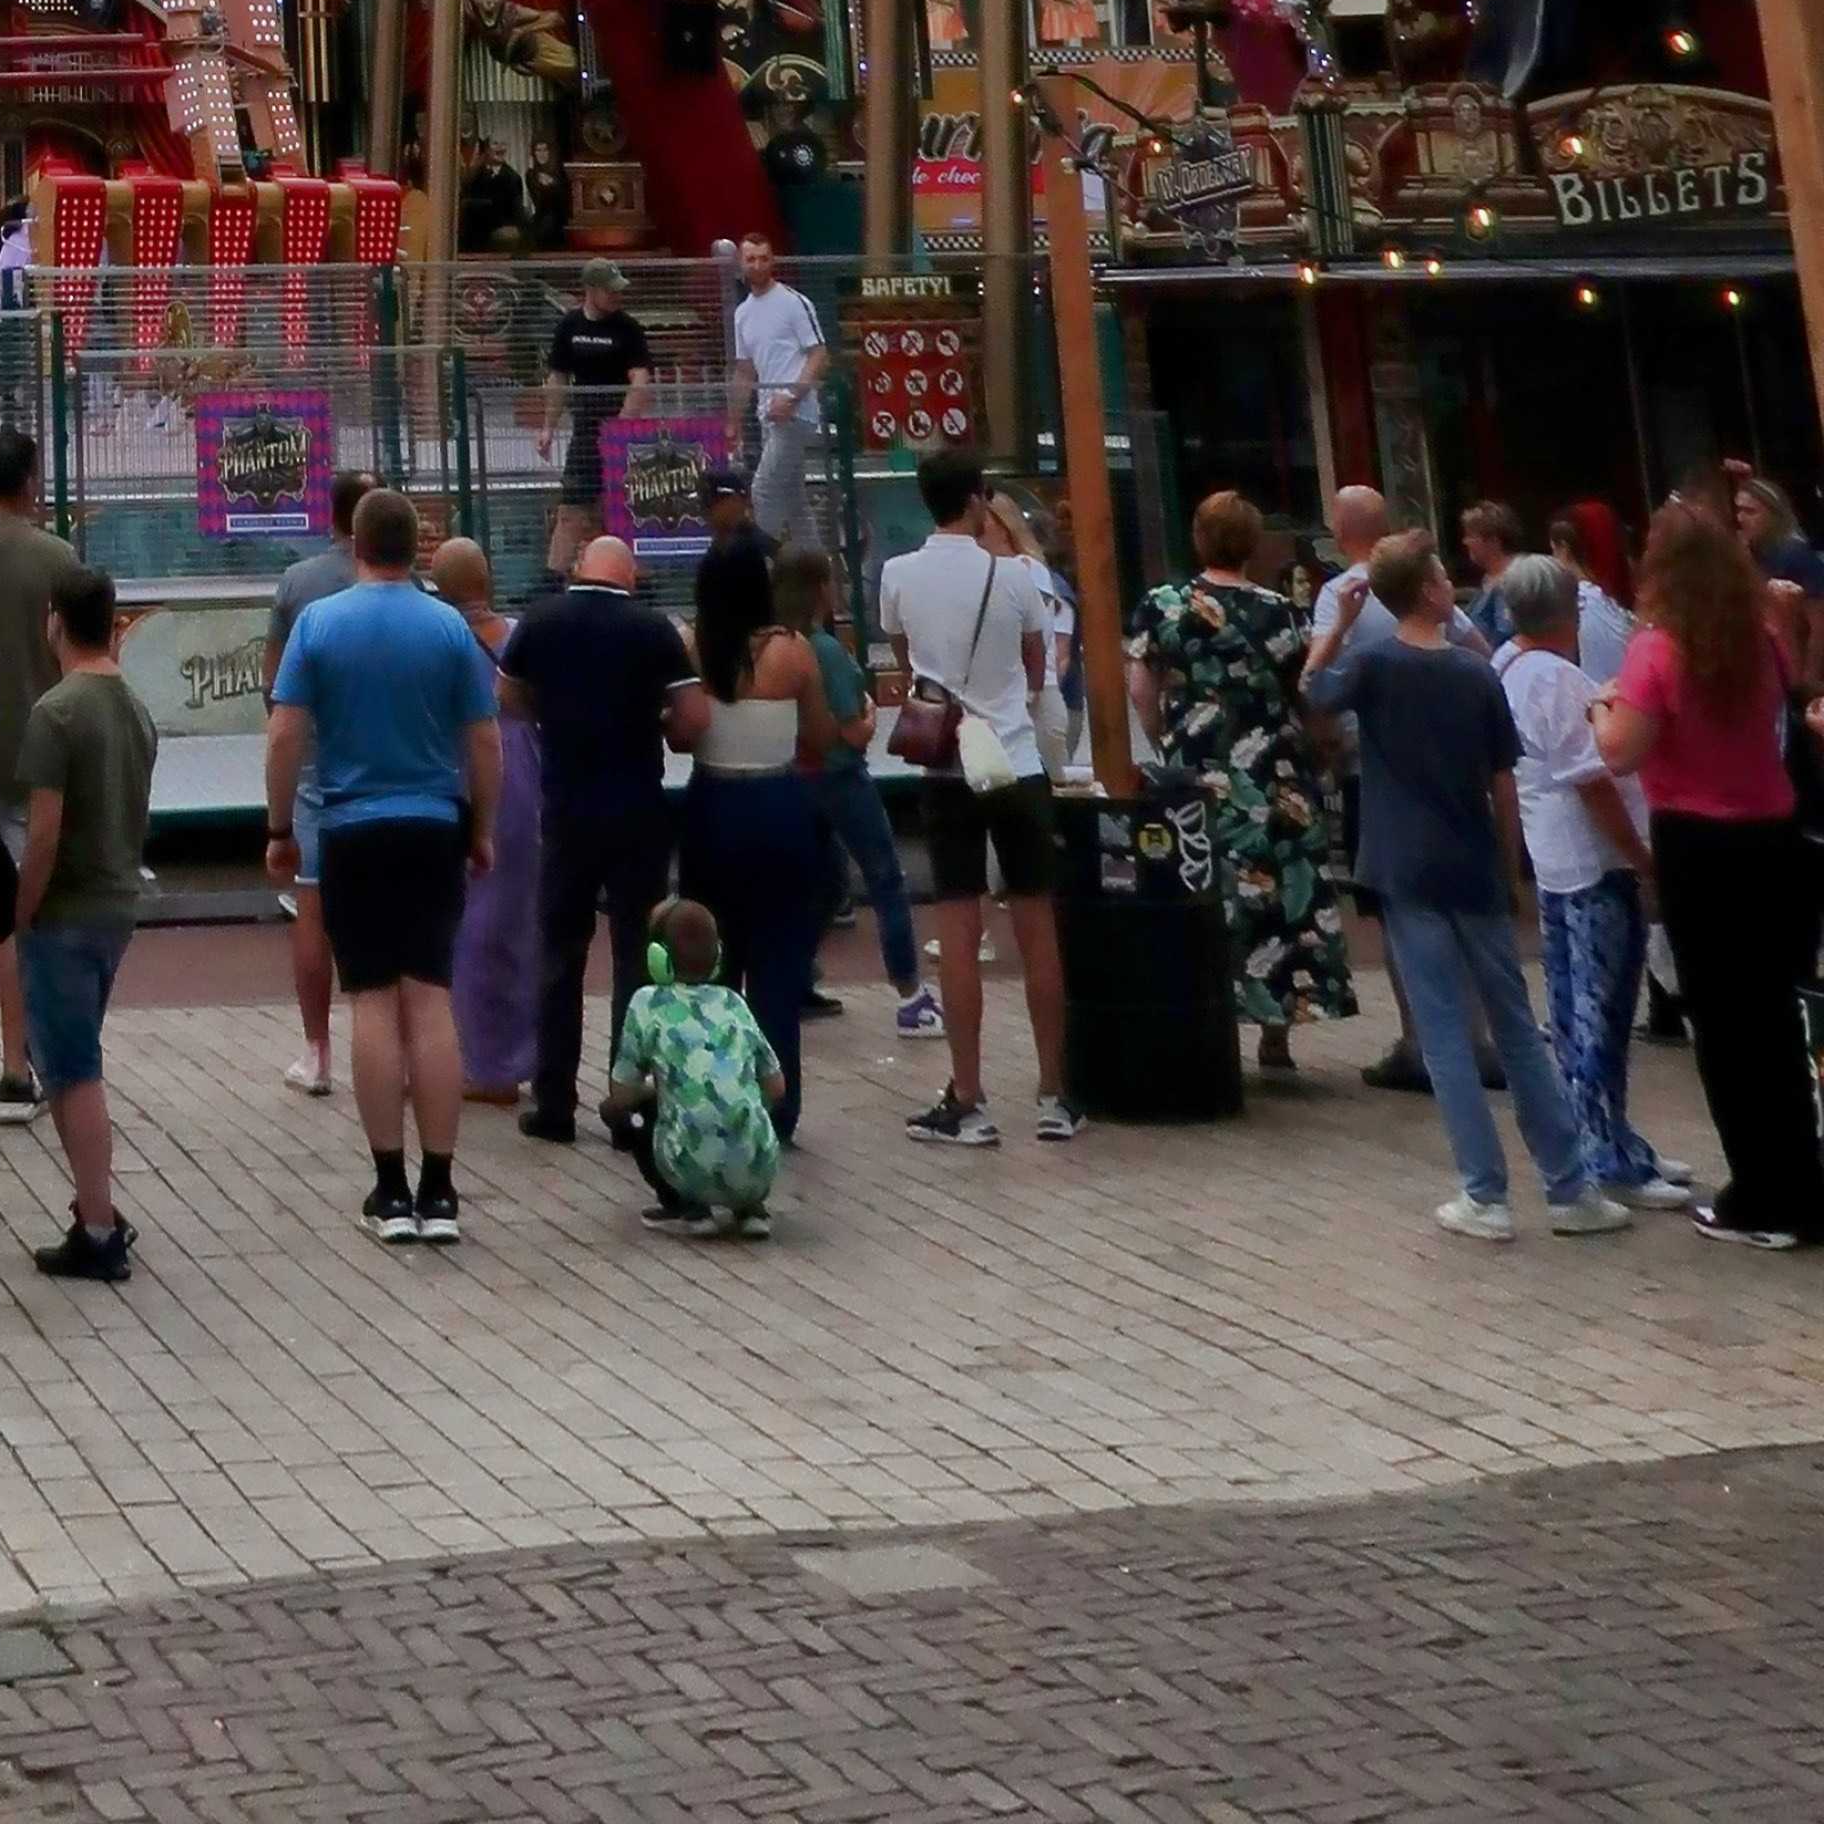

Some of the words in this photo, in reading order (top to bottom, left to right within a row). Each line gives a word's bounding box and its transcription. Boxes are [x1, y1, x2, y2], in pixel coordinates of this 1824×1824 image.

[1549, 151, 1768, 226] BILLETS
[860, 276, 952, 297] SAFETY!
[220, 432, 307, 480] PHANTOM
